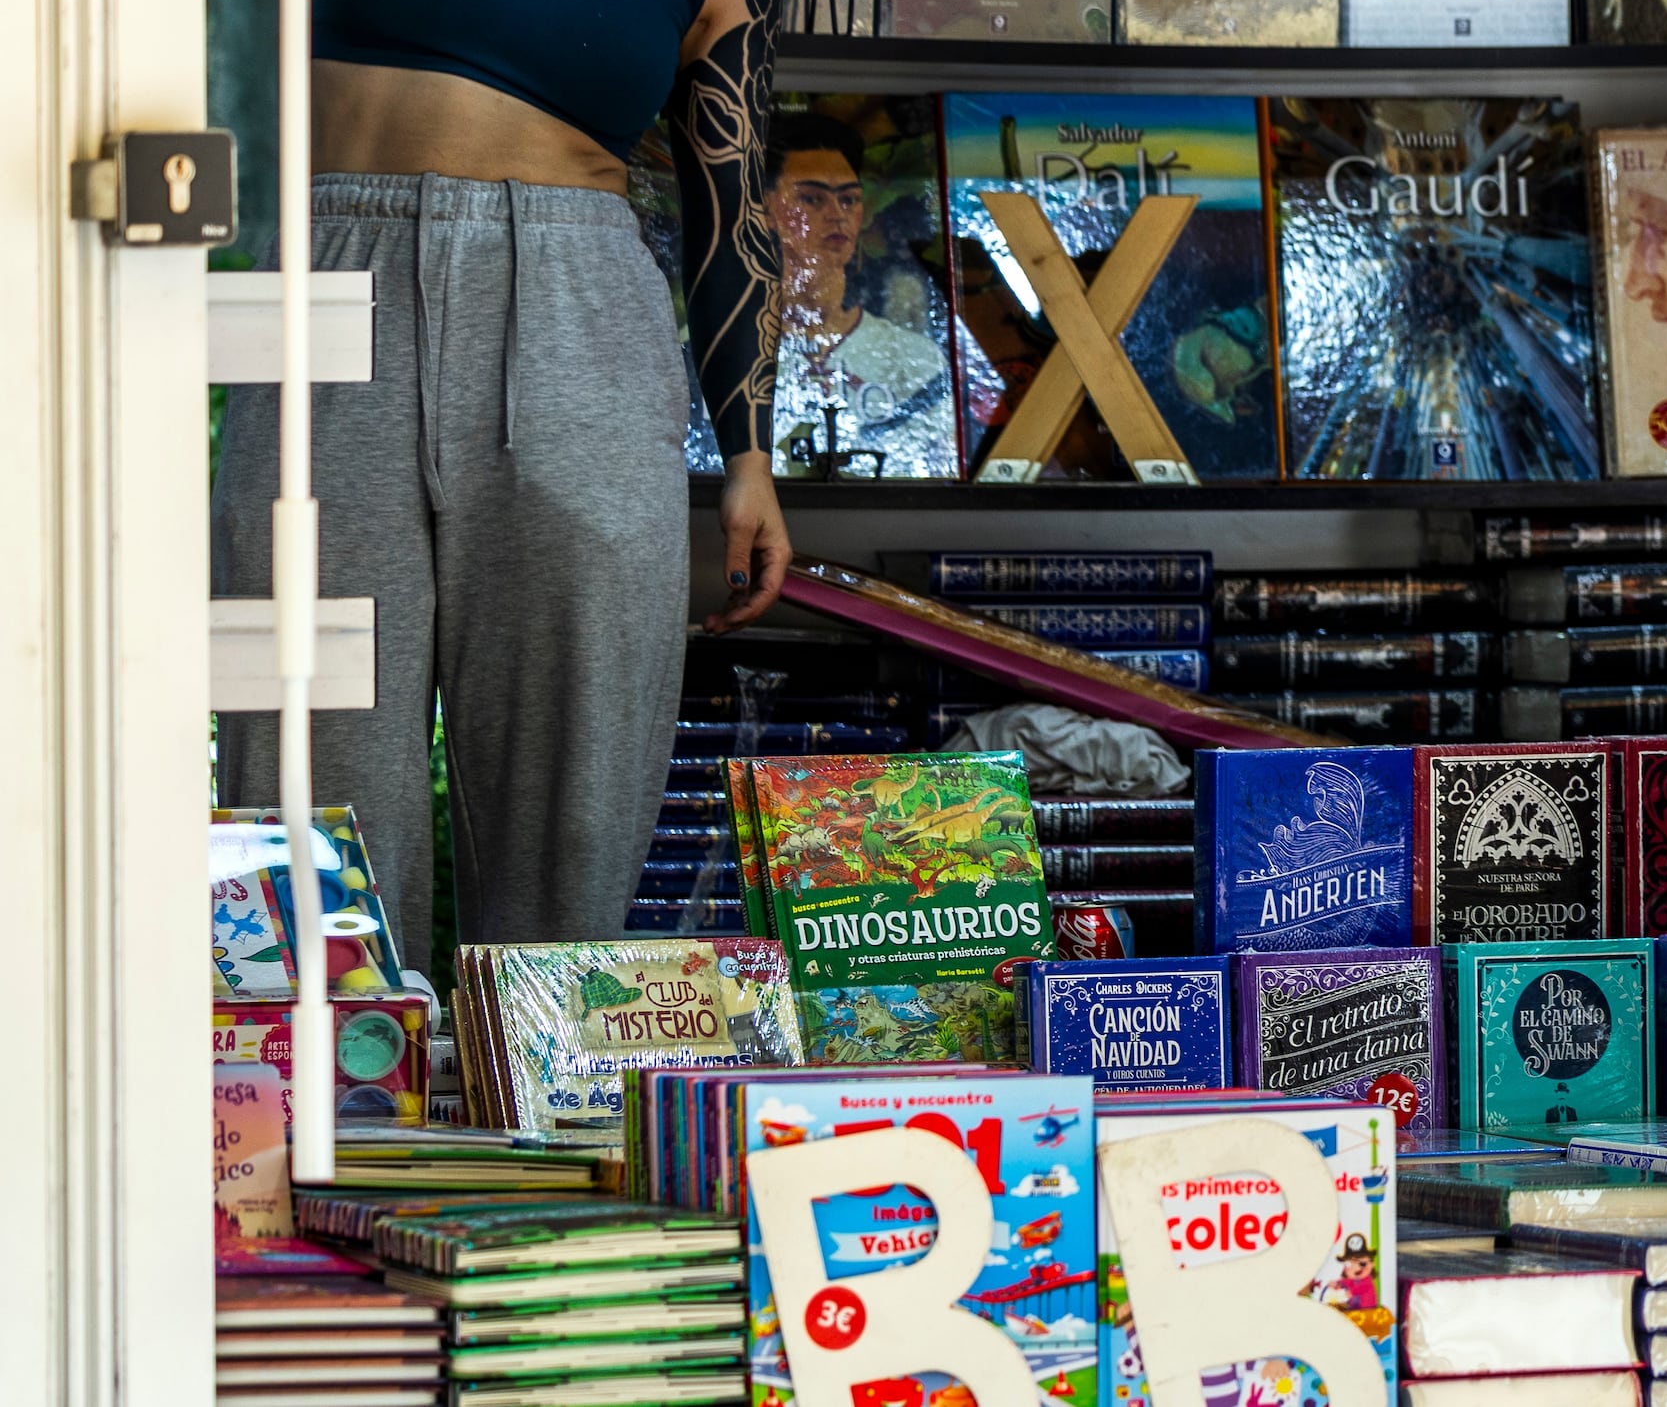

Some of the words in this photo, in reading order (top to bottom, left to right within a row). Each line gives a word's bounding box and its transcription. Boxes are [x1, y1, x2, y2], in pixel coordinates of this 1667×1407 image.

[1058, 123, 1144, 144] Salvador
[1391, 129, 1457, 149] Antoni
[1621, 148, 1649, 172] EL
[1325, 154, 1535, 218] Gaudí
[1478, 873, 1521, 884] NUESTRA
[1523, 871, 1561, 883] SEÑORA
[1260, 866, 1386, 927] ANDERSEN
[794, 901, 1042, 952] DINOSAURIOS
[848, 956, 855, 967] y
[858, 953, 886, 965] otras
[888, 950, 936, 962] criaturas
[938, 945, 1006, 960] prehistóricas
[646, 981, 698, 1008] CLUB
[698, 995, 713, 1007] del
[1095, 980, 1133, 995] CHARLES
[1135, 980, 1173, 994] DICKENS
[1540, 973, 1583, 1011] POR
[602, 1009, 718, 1041] MISTERIO
[1089, 1002, 1181, 1038] CANCIÓN
[1287, 1019, 1316, 1049] El
[1320, 992, 1402, 1036] retrato
[1520, 1010, 1539, 1028] EL
[1541, 1006, 1604, 1027] CAMINO
[1552, 1026, 1573, 1043] DE
[1090, 1038, 1181, 1070] NAVIDAD
[1268, 1063, 1298, 1090] de
[1302, 1051, 1350, 1082] una
[1355, 1026, 1425, 1067] dama
[1523, 1029, 1600, 1078] SWANN
[1374, 1086, 1413, 1113] 12€
[817, 1300, 854, 1333] 3€
